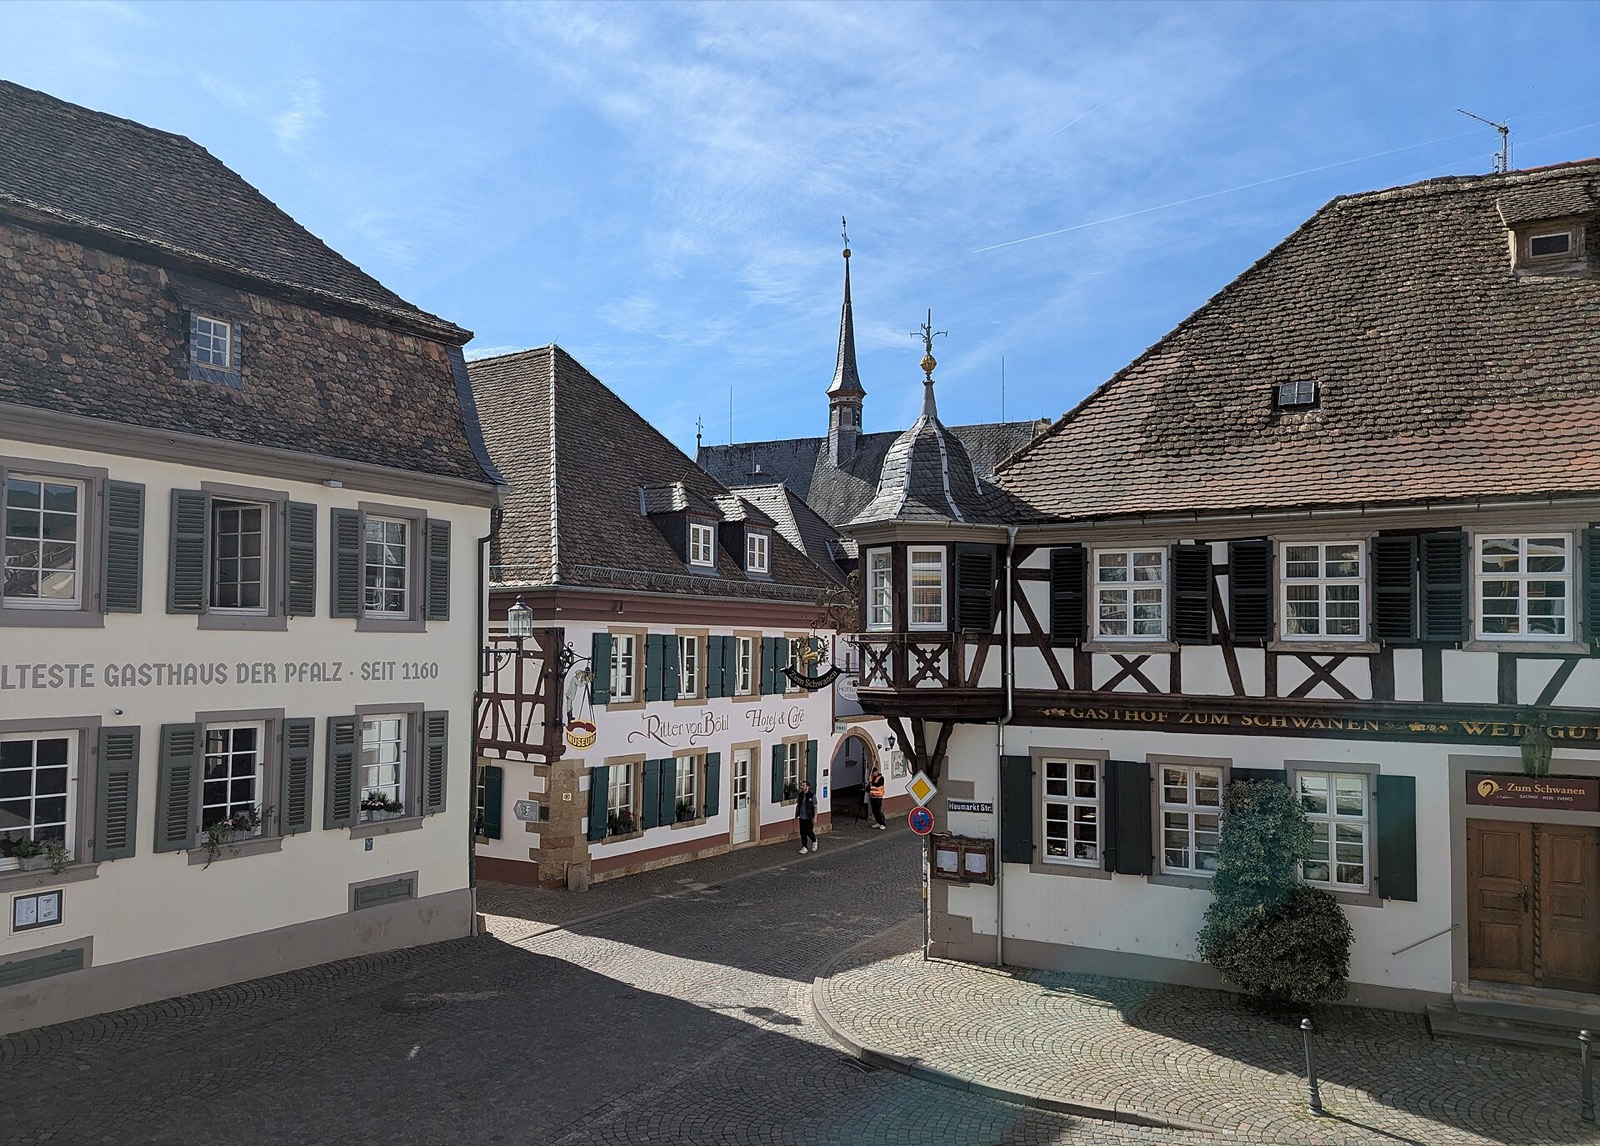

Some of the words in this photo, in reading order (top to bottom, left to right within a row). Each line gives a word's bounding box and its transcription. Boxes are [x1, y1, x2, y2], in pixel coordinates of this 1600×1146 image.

[1, 664, 96, 690] LTESTE
[104, 662, 229, 688] GASTHAUS
[236, 662, 277, 685] DER
[285, 661, 343, 683] PFALZ
[360, 661, 397, 681] SEIT
[402, 661, 439, 680] 1160
[788, 671, 804, 685] Zum
[804, 670, 838, 688] Schwanen
[686, 721, 703, 735] von
[689, 709, 730, 746] Böhl
[745, 708, 777, 734] Hotel
[778, 711, 785, 725] &
[787, 705, 805, 730] Café
[1070, 707, 1169, 723] GASTHOF
[1179, 712, 1230, 725] ZUM
[1241, 714, 1380, 731] SCHWANEN
[567, 734, 596, 747] MUSEUM
[627, 712, 684, 748] Ritter
[1507, 783, 1532, 792] Zum
[1533, 784, 1586, 795] Schwanen
[948, 802, 980, 812] Heumarkt
[980, 802, 993, 812] Str.
